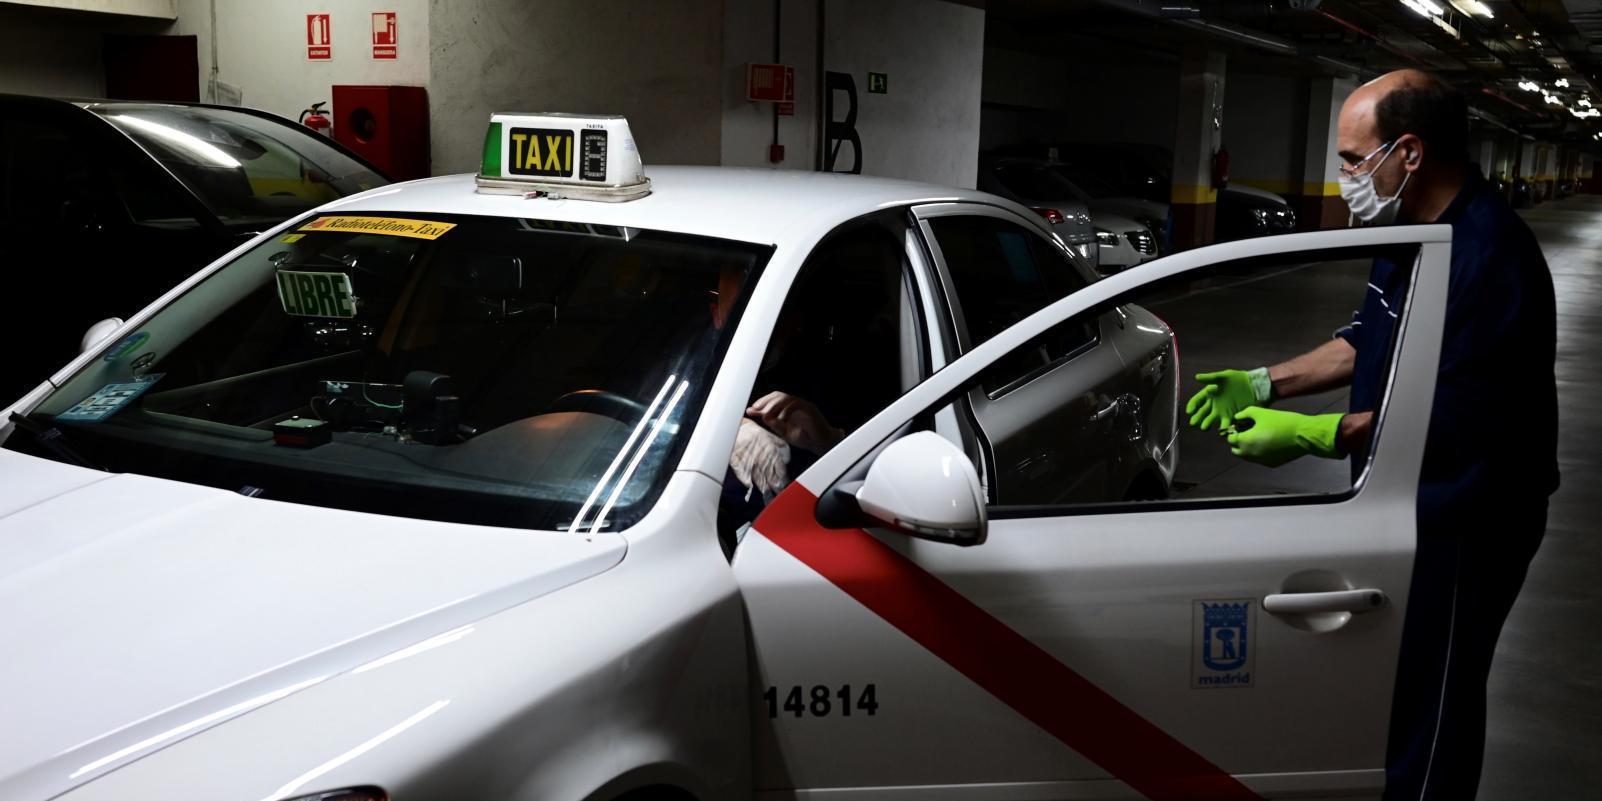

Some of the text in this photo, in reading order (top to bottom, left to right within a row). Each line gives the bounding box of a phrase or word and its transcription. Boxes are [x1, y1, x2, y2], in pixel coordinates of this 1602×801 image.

[512, 133, 572, 171] TAXI
[278, 273, 351, 316] LIBRE
[1199, 672, 1249, 685] madrid
[763, 684, 879, 719] 14814
